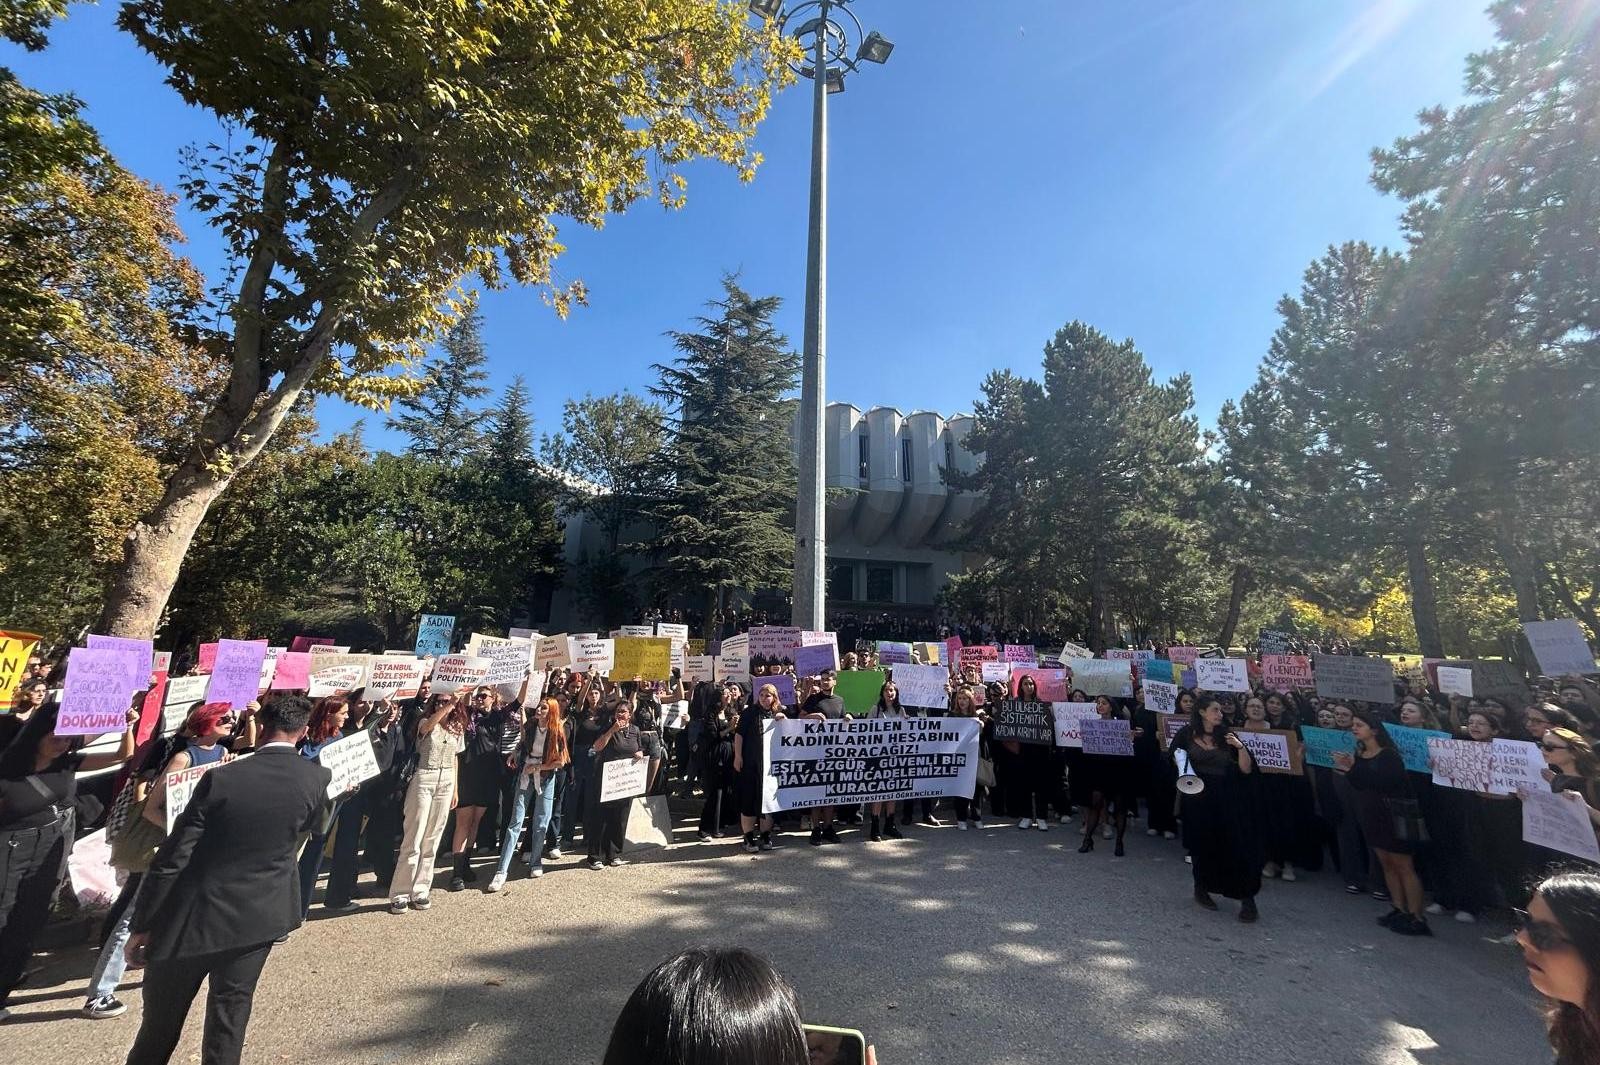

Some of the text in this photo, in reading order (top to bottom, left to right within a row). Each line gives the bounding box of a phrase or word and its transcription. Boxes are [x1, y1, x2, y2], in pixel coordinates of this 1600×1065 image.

[374, 662, 413, 671] İSTANBUL
[440, 658, 466, 666] KADIN
[1278, 655, 1291, 665] BİZ
[372, 671, 420, 680] SÖZLEŞMESİ
[438, 666, 487, 676] CİNAYETLERİ
[371, 681, 406, 689] YAŞATIR!
[1002, 701, 1044, 714] BU ÜLKEDE
[61, 714, 126, 729] DOKUNMA
[804, 718, 941, 734] KATLEDİLEN TÜM
[1000, 713, 1048, 726] SİSTEMATİK
[780, 732, 960, 747] KADINLARIN HESABINI
[995, 725, 1016, 737] KADIN
[1039, 729, 1052, 741] VAR
[824, 743, 919, 758] SORACAĞIZ!
[1242, 739, 1282, 751] GÜVENLİ
[815, 759, 866, 772] ÖZGÜR
[880, 753, 938, 768] GÜVENLİ
[942, 753, 966, 766] BİR
[779, 764, 959, 786] HAYATI MÜCADELEMİZLE
[825, 779, 914, 795] KURACAĞIZ!
[791, 788, 944, 807] HACETTEPE ÜNİVERSİTESİ ÖĞRENCİLERİ
